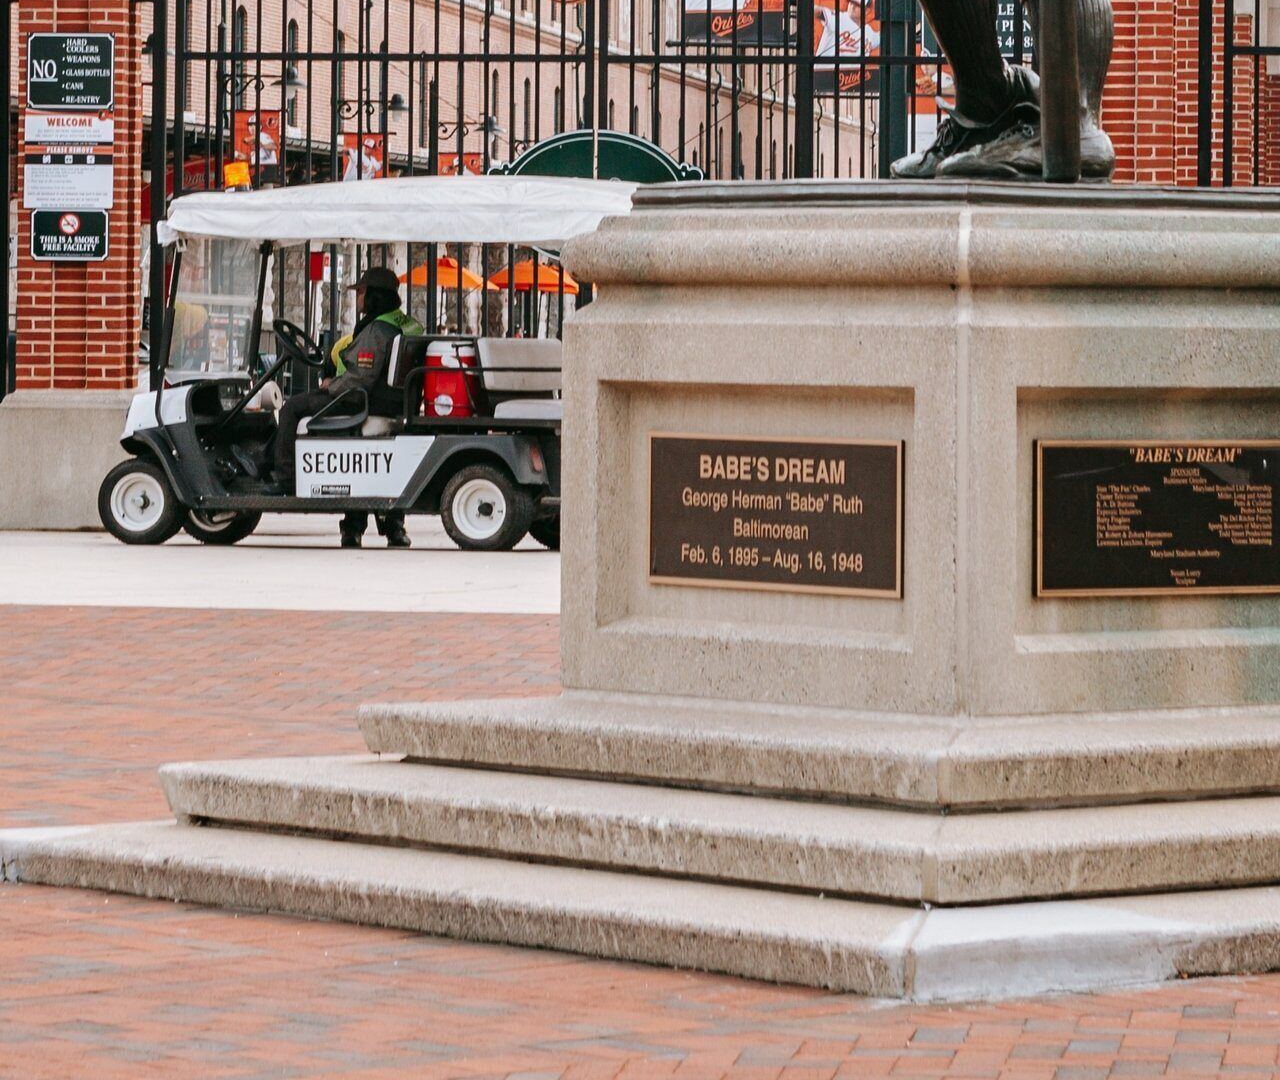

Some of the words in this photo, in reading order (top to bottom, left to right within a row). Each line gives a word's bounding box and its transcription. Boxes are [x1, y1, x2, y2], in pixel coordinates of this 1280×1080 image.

[711, 13, 755, 37] Oriles
[66, 38, 87, 46] HARD
[66, 45, 99, 53] COOLERS
[66, 55, 100, 63] WEAPONS
[32, 59, 57, 79] NO
[65, 69, 85, 77] GLASS
[85, 69, 111, 77] BOTTLES
[65, 82, 84, 90] CANS
[65, 95, 100, 104] RE-ENTRY
[47, 118, 93, 127] WELCOME
[46, 145, 68, 153] PLEASE
[68, 145, 93, 153] REMOVE
[40, 235, 57, 244] THIS
[58, 235, 66, 244] IS
[66, 235, 73, 244] A
[74, 235, 100, 245] SMOKE
[42, 243, 62, 252] FREE
[63, 243, 97, 252] FACILITY
[1129, 447, 1184, 463] "BABE'S
[1187, 447, 1242, 463] DREAM"
[302, 452, 394, 474] SECURITY
[699, 454, 770, 482] BABE'S
[775, 457, 846, 485] DREAM
[682, 487, 729, 512] George
[732, 488, 782, 510] Herman
[832, 493, 863, 515] Ruth
[733, 517, 809, 541] Baltimorean
[680, 543, 708, 564] Feb.
[712, 546, 724, 567] 6,
[728, 546, 759, 567] 1895
[773, 549, 802, 574] Aug.
[807, 552, 827, 574] 16,
[831, 553, 864, 573] 1948
